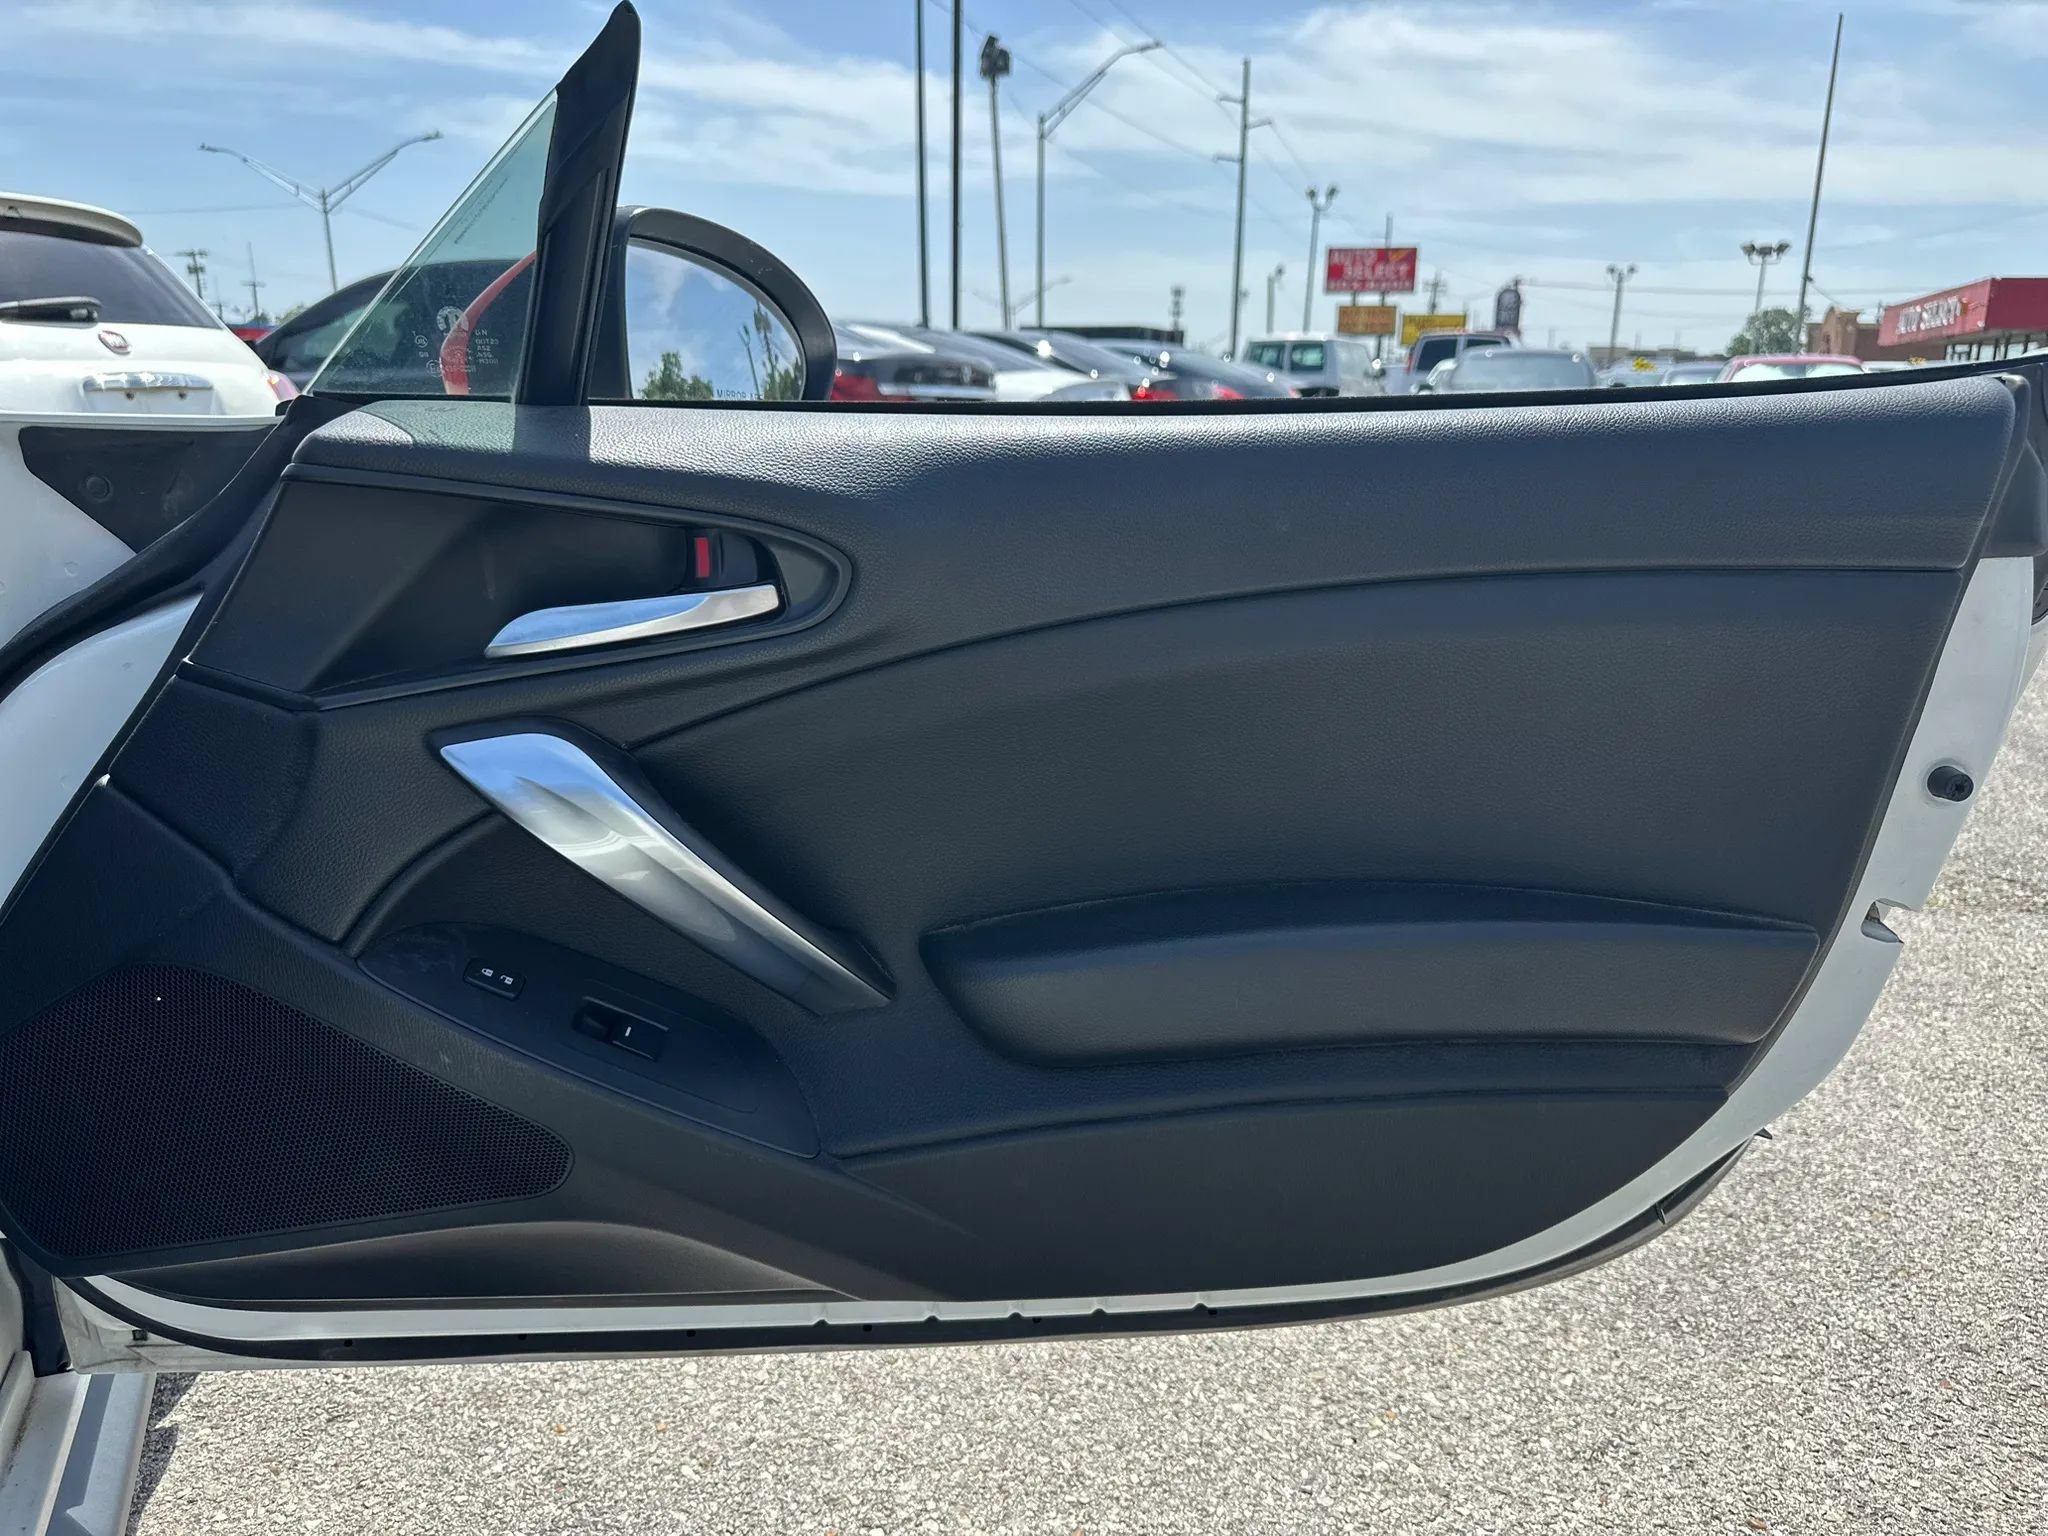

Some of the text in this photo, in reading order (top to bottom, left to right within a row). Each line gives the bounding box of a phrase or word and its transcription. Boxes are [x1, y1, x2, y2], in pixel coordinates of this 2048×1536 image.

[1331, 250, 1377, 265] AUTO
[1343, 263, 1409, 281] SELECT
[1896, 295, 1962, 335] AUTO SELECT
